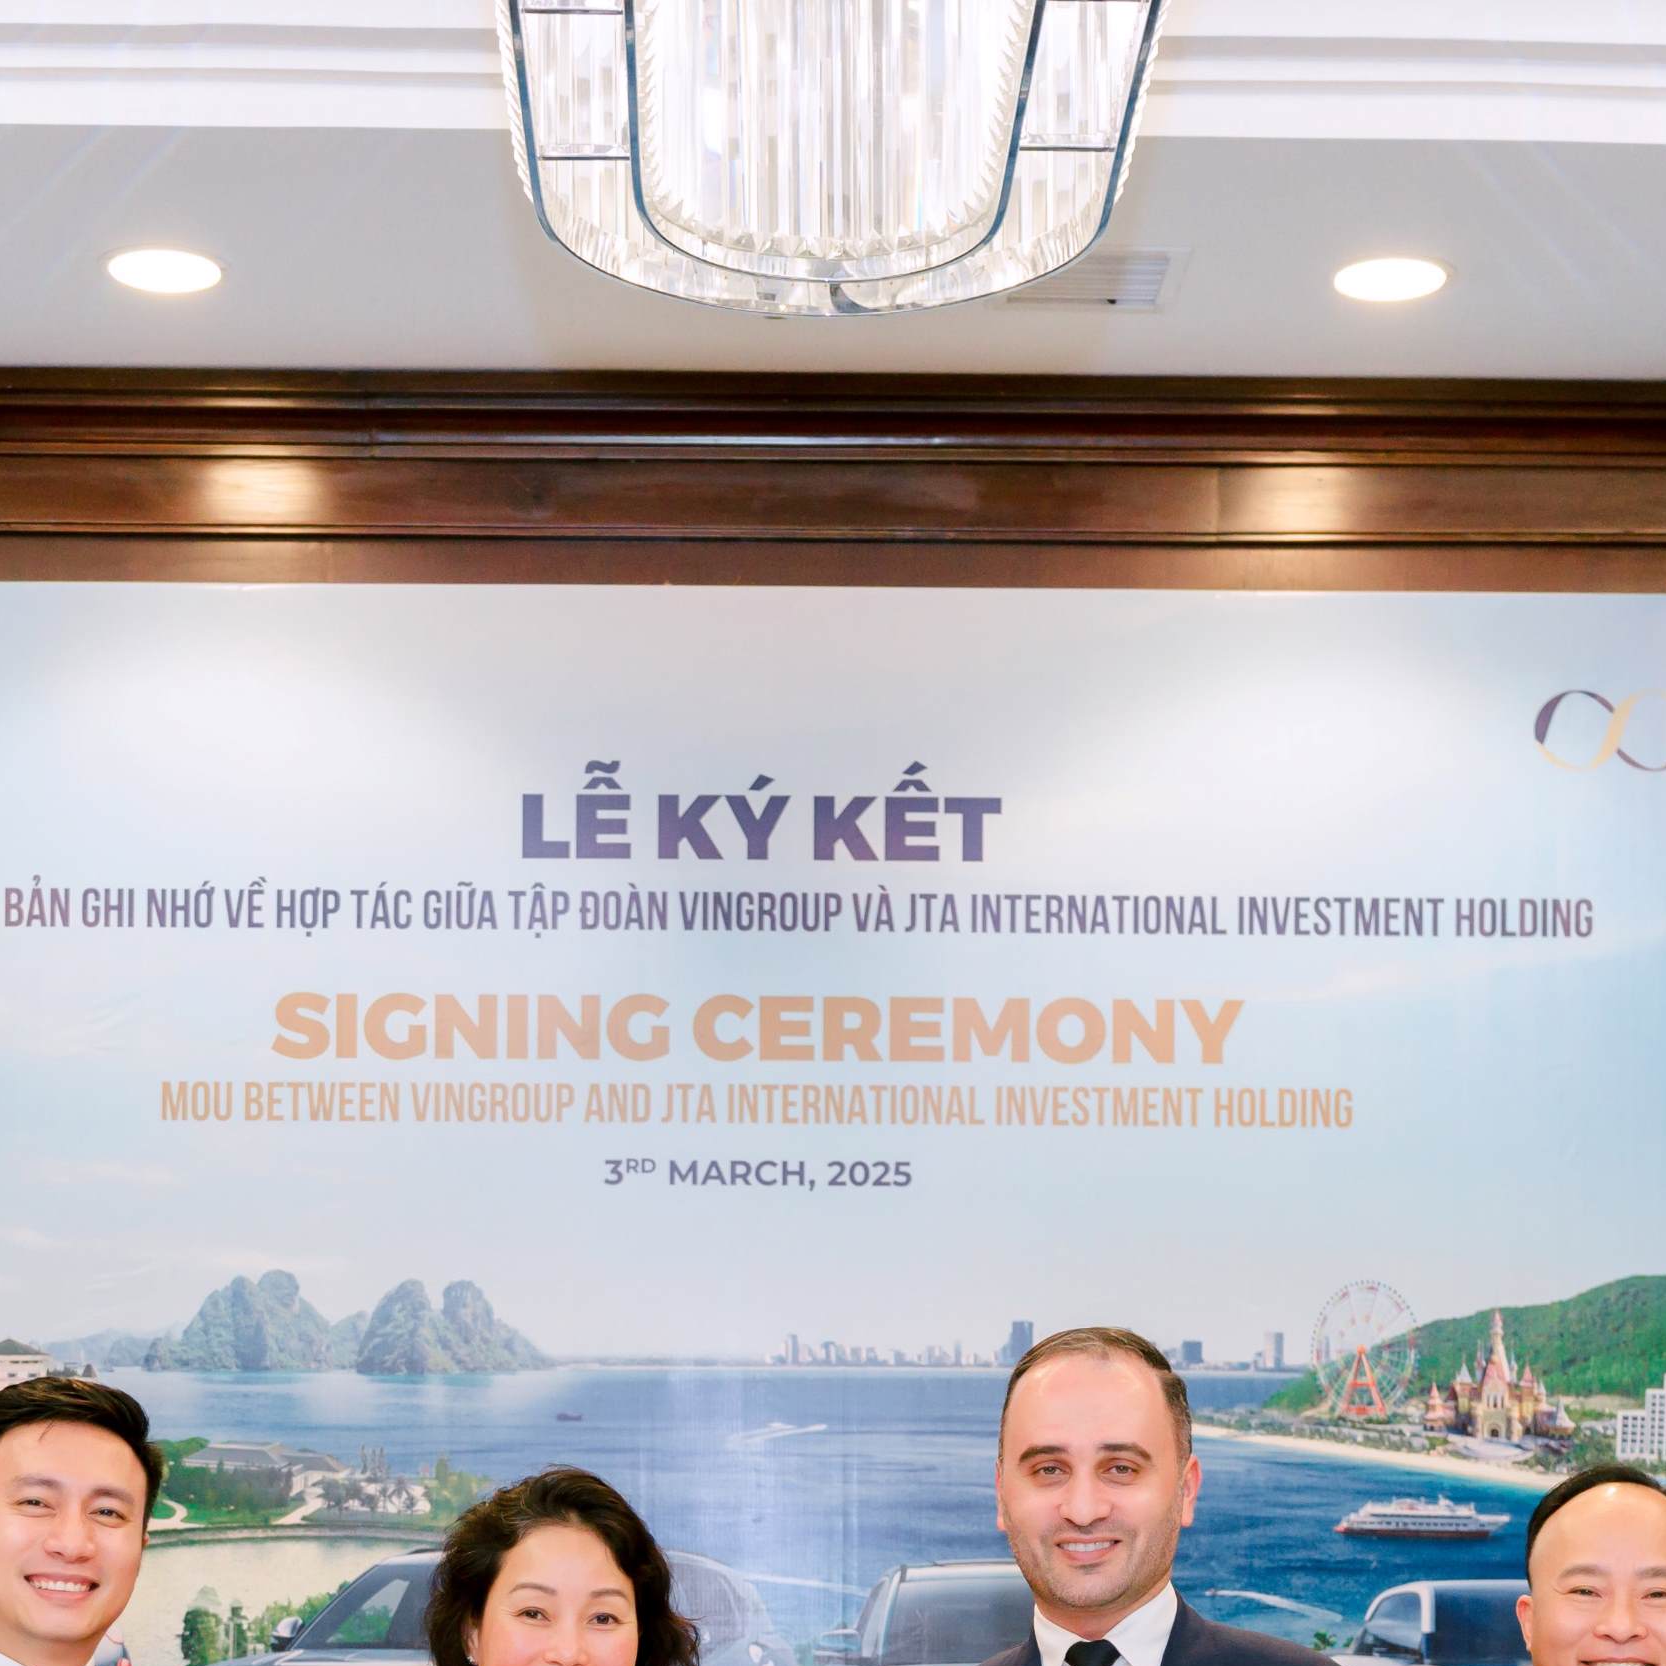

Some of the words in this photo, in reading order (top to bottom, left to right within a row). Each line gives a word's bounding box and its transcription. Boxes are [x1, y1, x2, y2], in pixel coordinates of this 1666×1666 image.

[521, 760, 632, 860] LỄ
[657, 773, 791, 861] KÝ
[813, 760, 1003, 862] KẾT
[5, 875, 69, 926] BẢN
[82, 888, 134, 927] GHI
[147, 881, 214, 928] NHỚ
[225, 877, 266, 928] VỀ
[277, 887, 340, 937] HỢP
[351, 882, 411, 929] TÁC
[424, 882, 497, 929] GIỮA
[508, 883, 569, 938] TẬP
[580, 883, 667, 930] ĐOÀN
[679, 892, 842, 931] VINGROUP
[853, 885, 894, 932] VÀ
[905, 894, 959, 932] JTA
[972, 894, 1226, 934] INTERNATIONAL
[1239, 897, 1444, 936] INVESTMENT
[1456, 899, 1592, 937] HOLDING
[271, 991, 671, 1063] SIGNING
[691, 994, 1246, 1066] CEREMONY
[161, 1081, 233, 1121] MOU
[244, 1081, 400, 1122] BETWEEN
[411, 1082, 574, 1123] VINGROUP
[584, 1083, 651, 1123] AND
[661, 1083, 717, 1123] JTA
[728, 1084, 984, 1126] INTERNATIONAL
[995, 1086, 1204, 1128] INVESTMENT
[1214, 1088, 1353, 1129] HOLDING
[604, 1158, 657, 1187] 3RD
[669, 1160, 816, 1192] MARCH,
[827, 1161, 913, 1188] 2025
